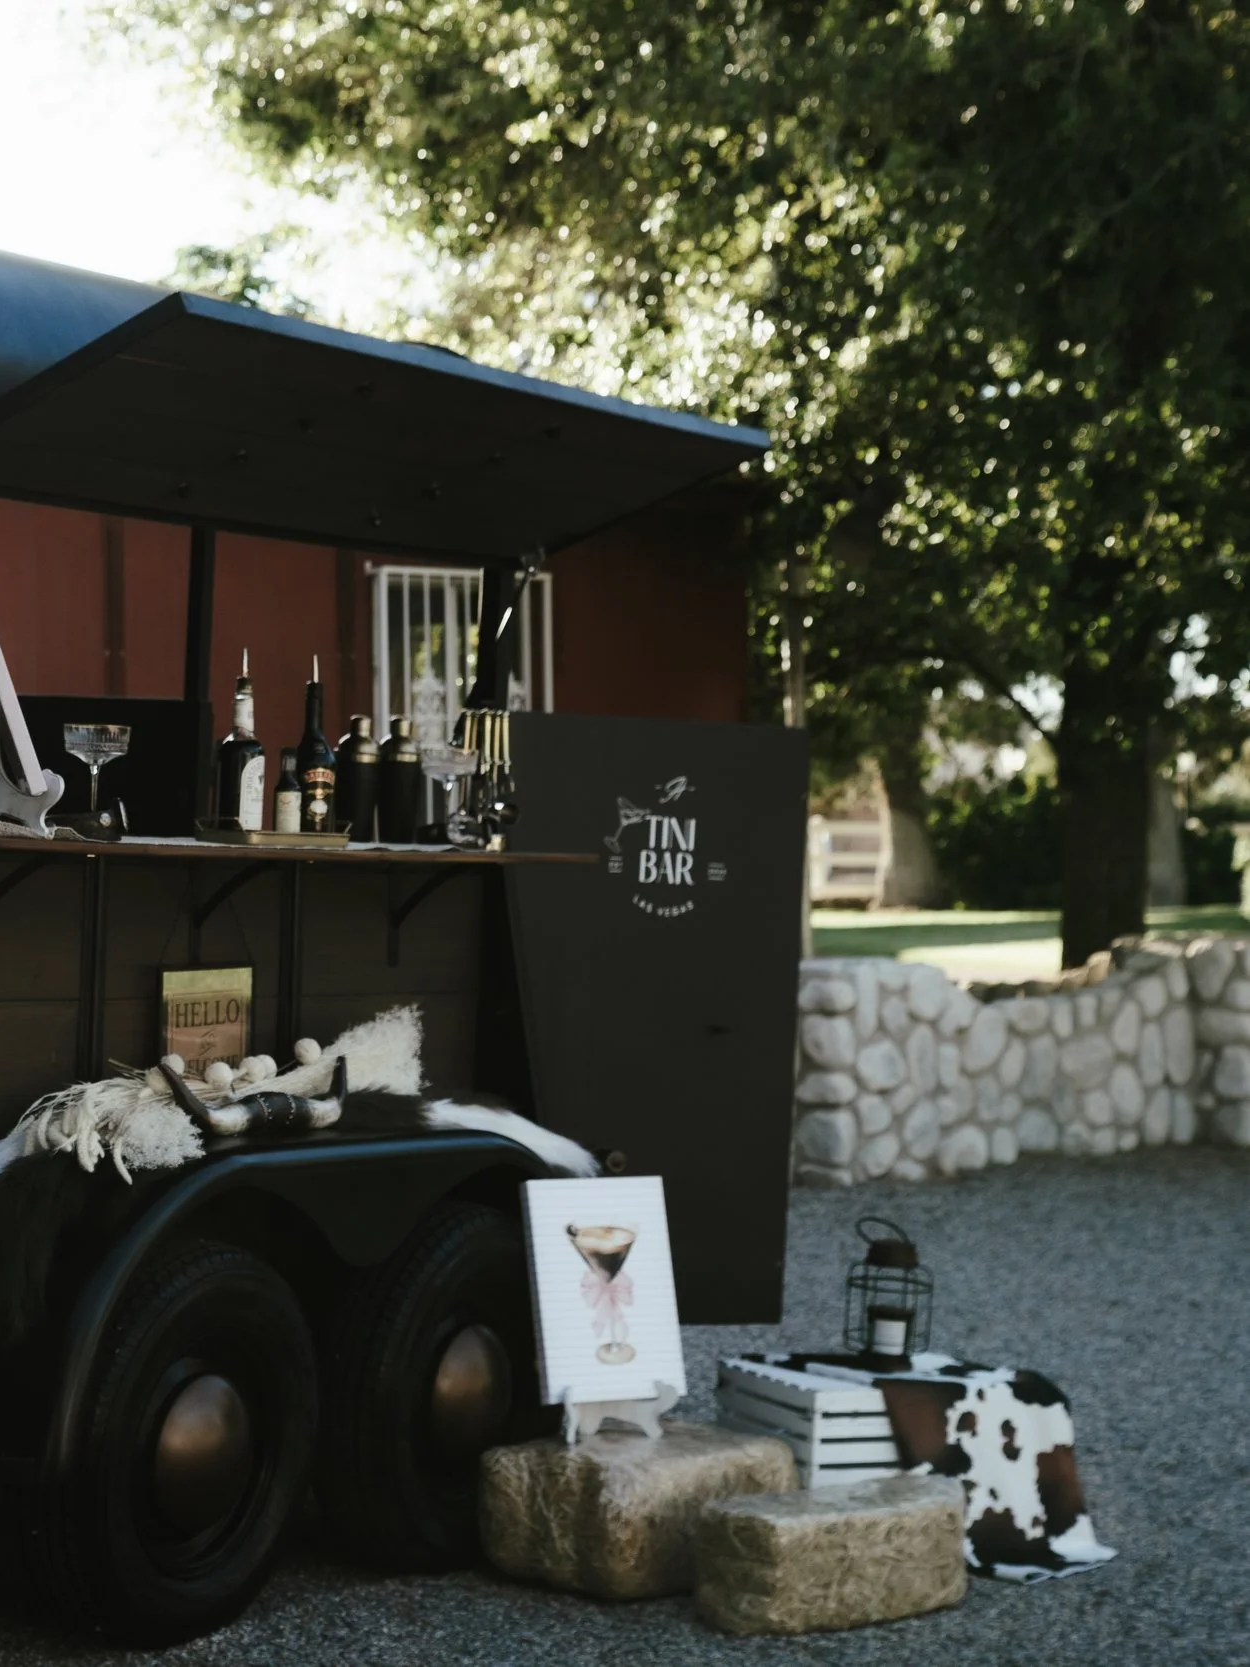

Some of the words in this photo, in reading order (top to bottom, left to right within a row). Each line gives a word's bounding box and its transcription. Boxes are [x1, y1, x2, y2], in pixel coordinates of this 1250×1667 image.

[645, 815, 696, 852] TINI
[639, 849, 695, 885] BAR
[175, 998, 240, 1028] HELLO
